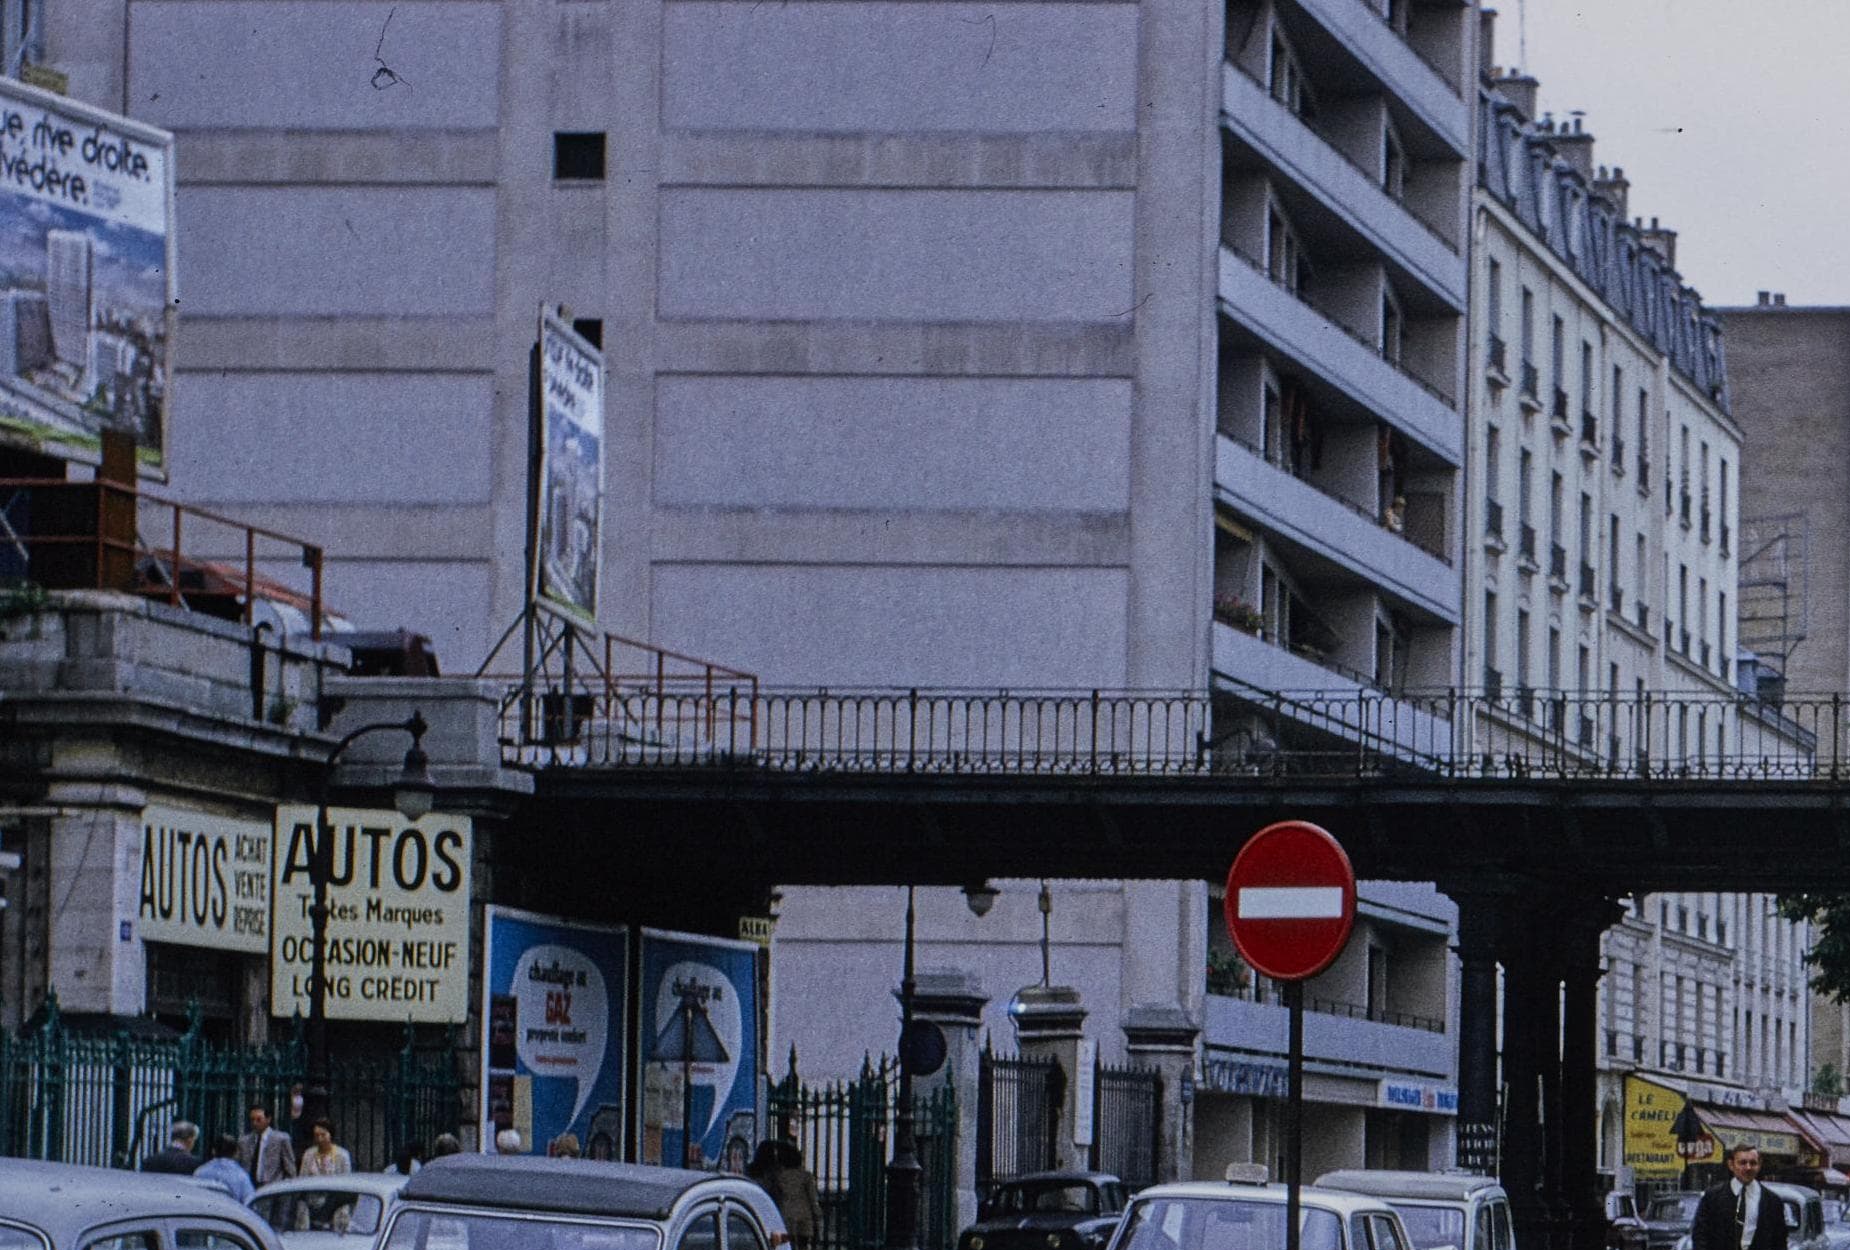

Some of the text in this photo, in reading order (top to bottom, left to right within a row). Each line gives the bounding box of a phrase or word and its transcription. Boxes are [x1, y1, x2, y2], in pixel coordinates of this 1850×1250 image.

[33, 114, 74, 156] rive
[82, 123, 150, 183] droite.
[234, 832, 268, 865] ACHAT
[281, 822, 463, 893] AUTOS
[139, 824, 227, 929] AUTOS
[234, 869, 267, 902] VENTE
[365, 897, 445, 930] Marques
